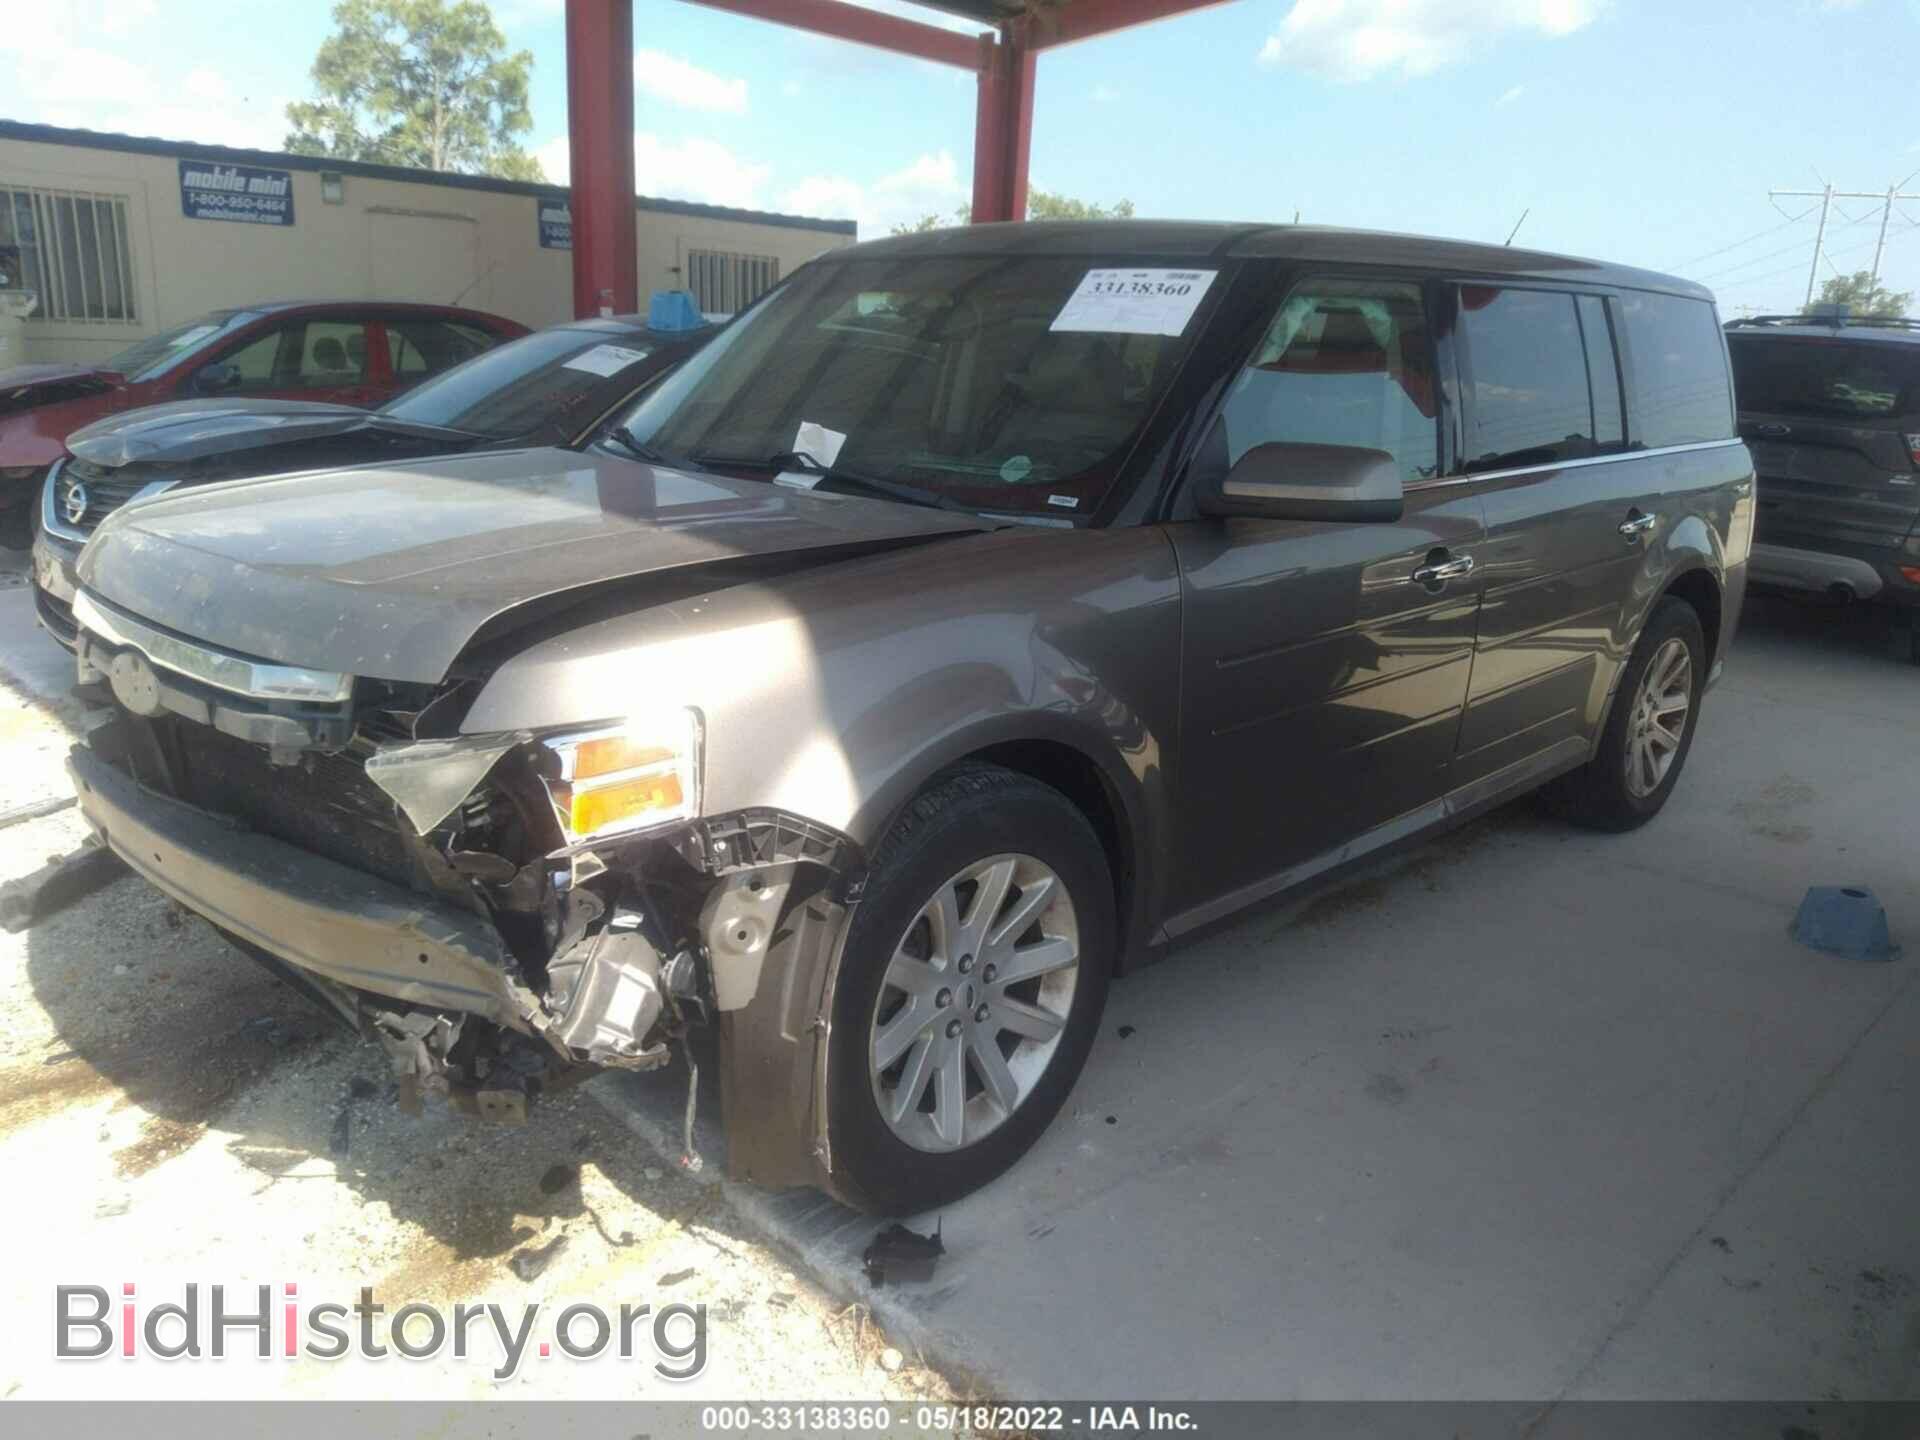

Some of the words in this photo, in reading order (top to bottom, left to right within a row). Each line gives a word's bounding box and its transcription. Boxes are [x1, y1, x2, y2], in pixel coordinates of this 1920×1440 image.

[184, 166, 246, 192] mobile
[248, 175, 288, 196] mini
[1095, 282, 1192, 297] 33138360
